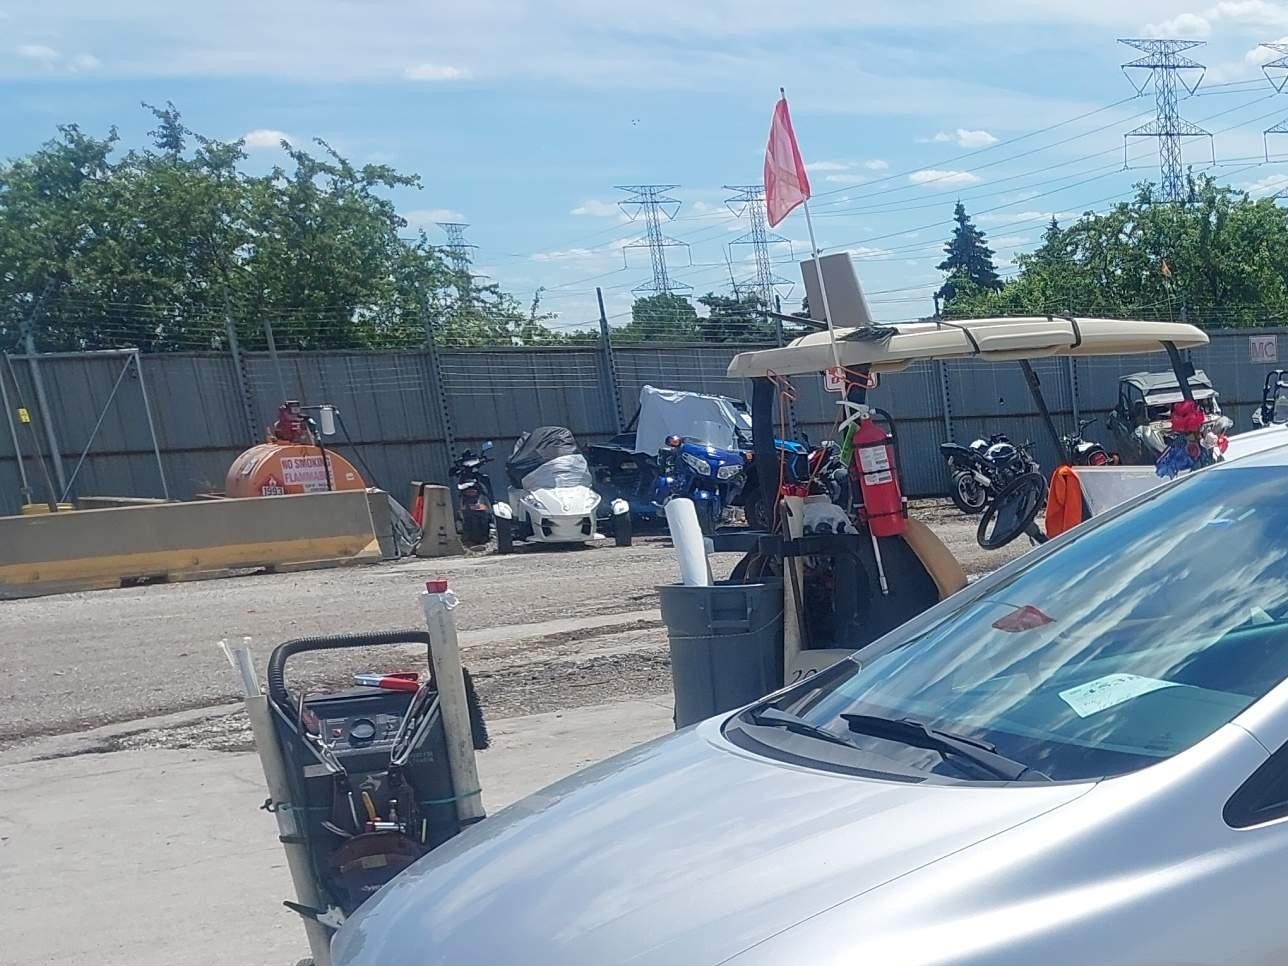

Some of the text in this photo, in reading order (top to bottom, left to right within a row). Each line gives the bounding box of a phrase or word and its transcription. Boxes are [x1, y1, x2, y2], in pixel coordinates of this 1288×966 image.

[1252, 342, 1276, 358] MC
[281, 459, 293, 469] NO
[284, 470, 333, 483] FLAMMABE
[264, 487, 283, 497] 1993
